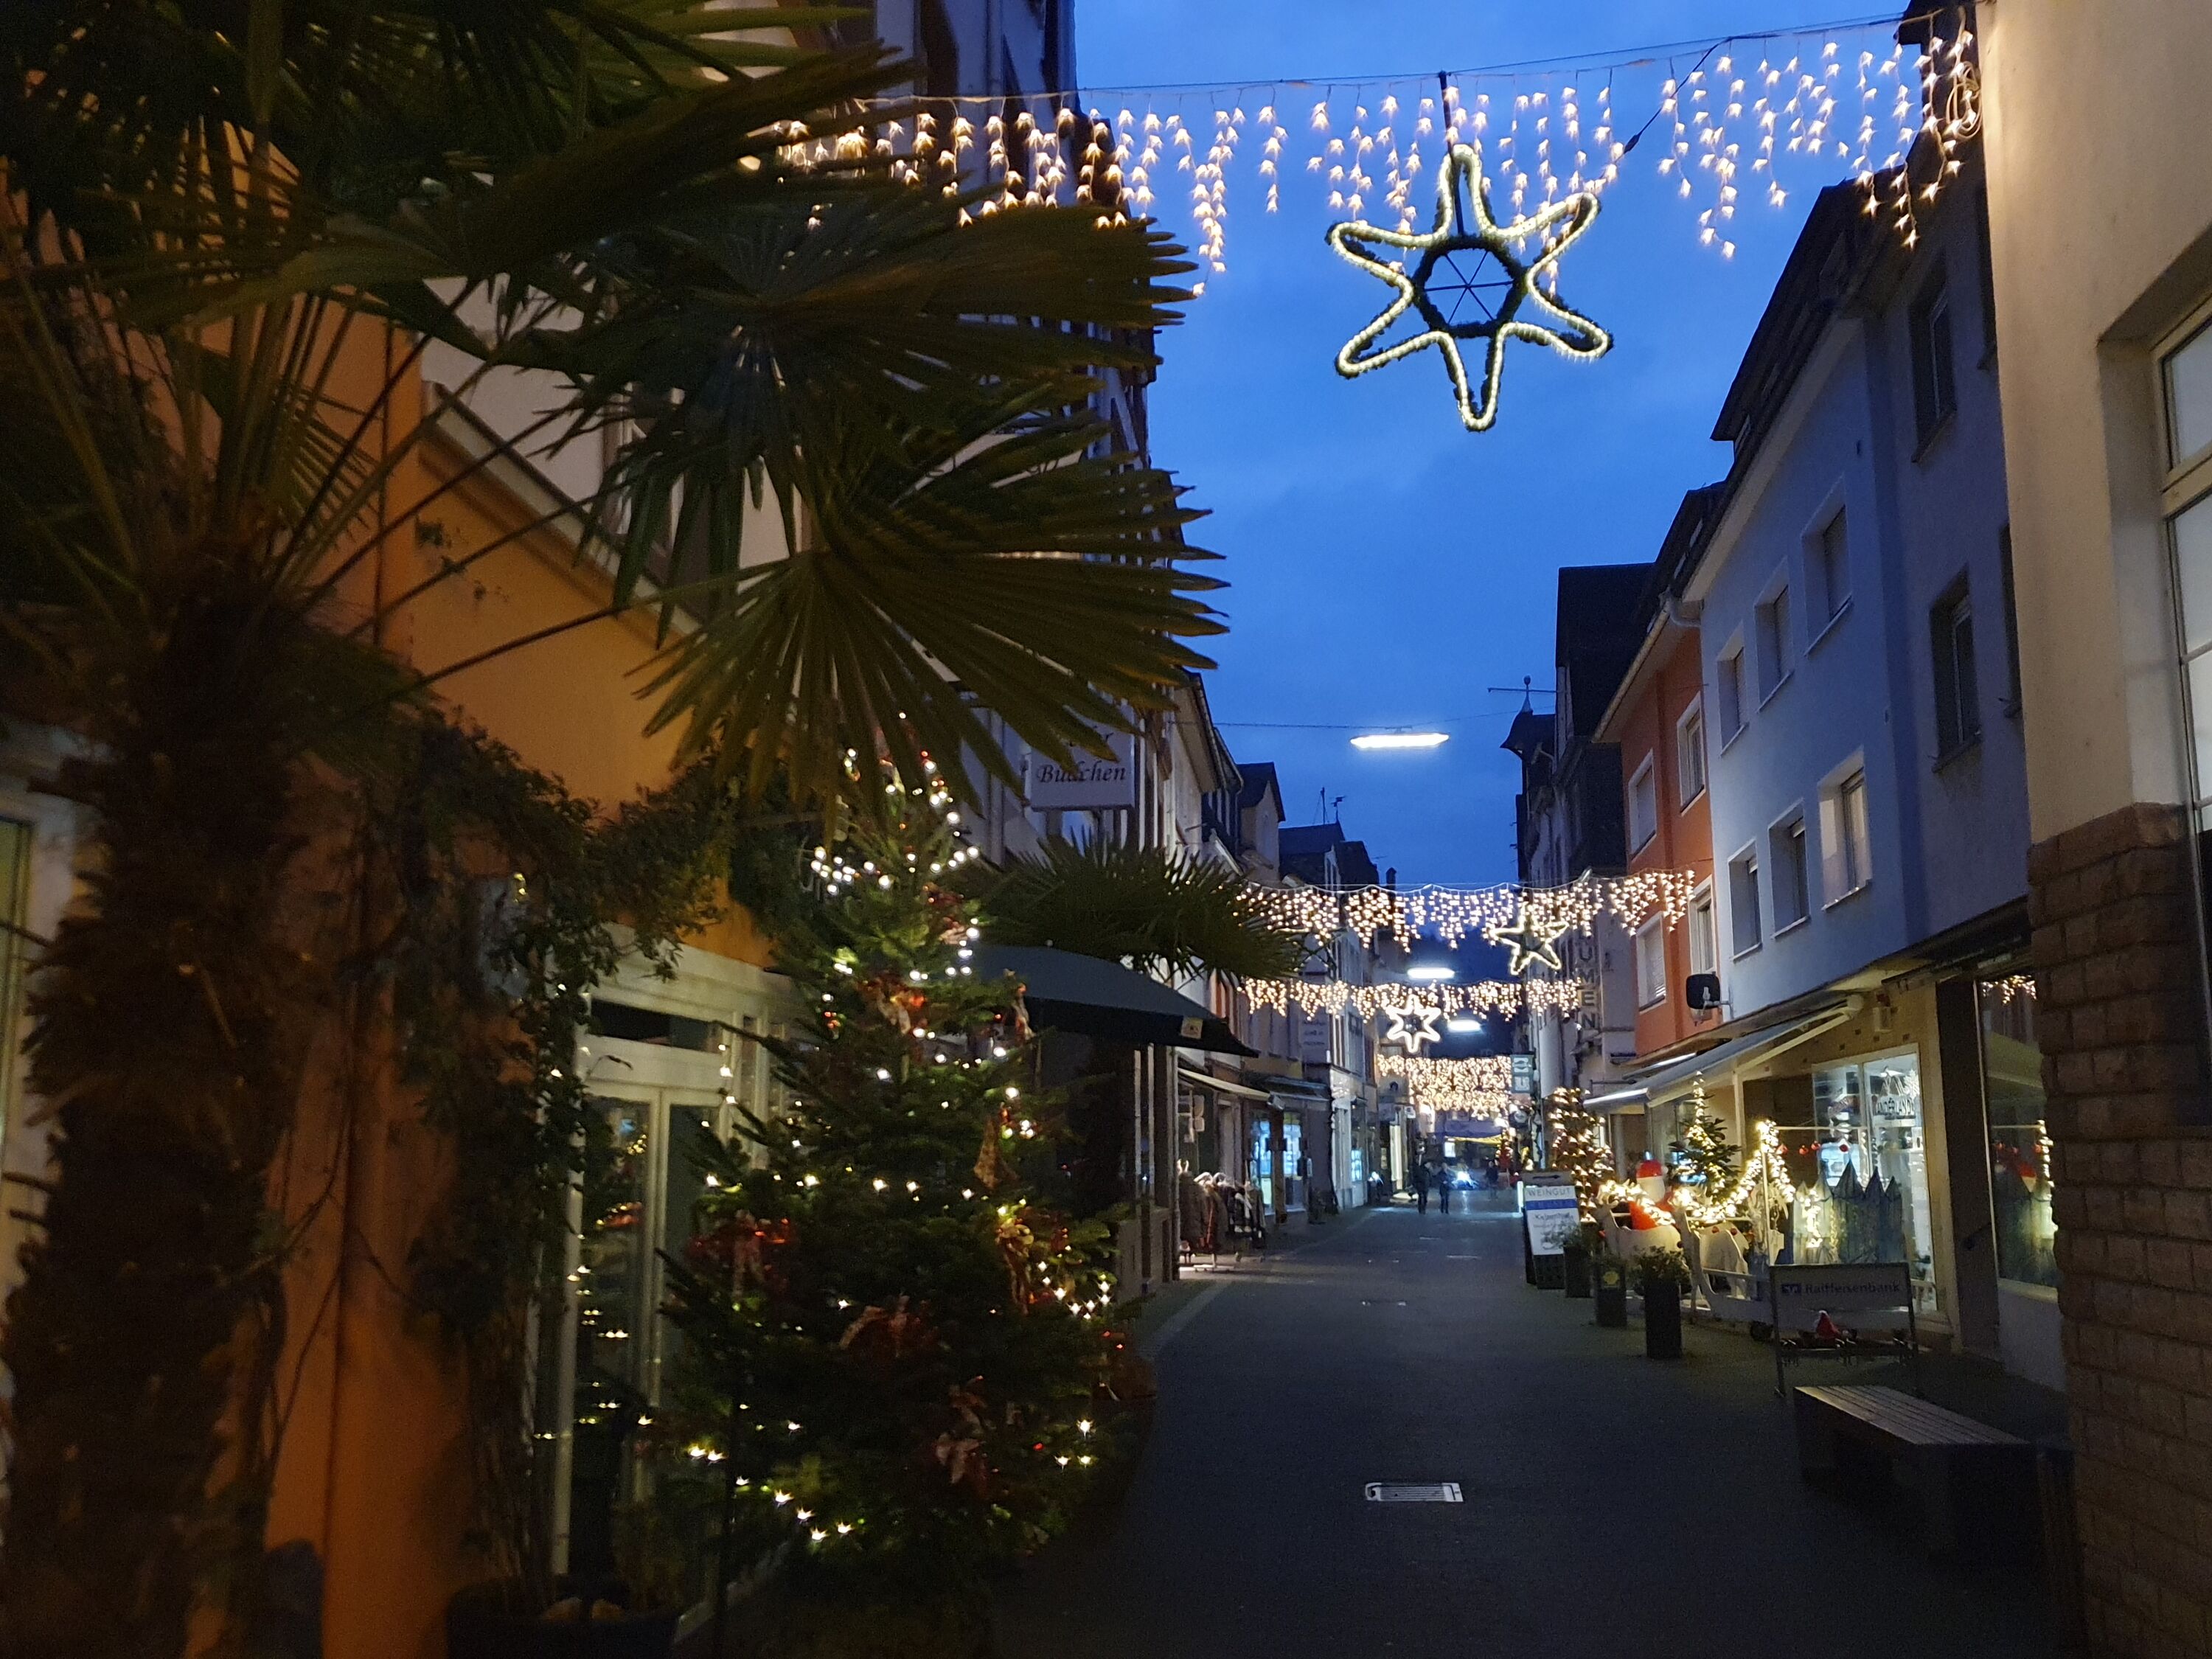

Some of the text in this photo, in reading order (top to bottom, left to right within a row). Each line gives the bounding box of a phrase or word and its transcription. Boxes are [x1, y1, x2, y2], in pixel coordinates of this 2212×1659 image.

[1579, 920, 1596, 1029] LUMEN
[1527, 1187, 1570, 1197] WEINGUT
[1805, 1280, 1900, 1294] Raiffeisenbank
